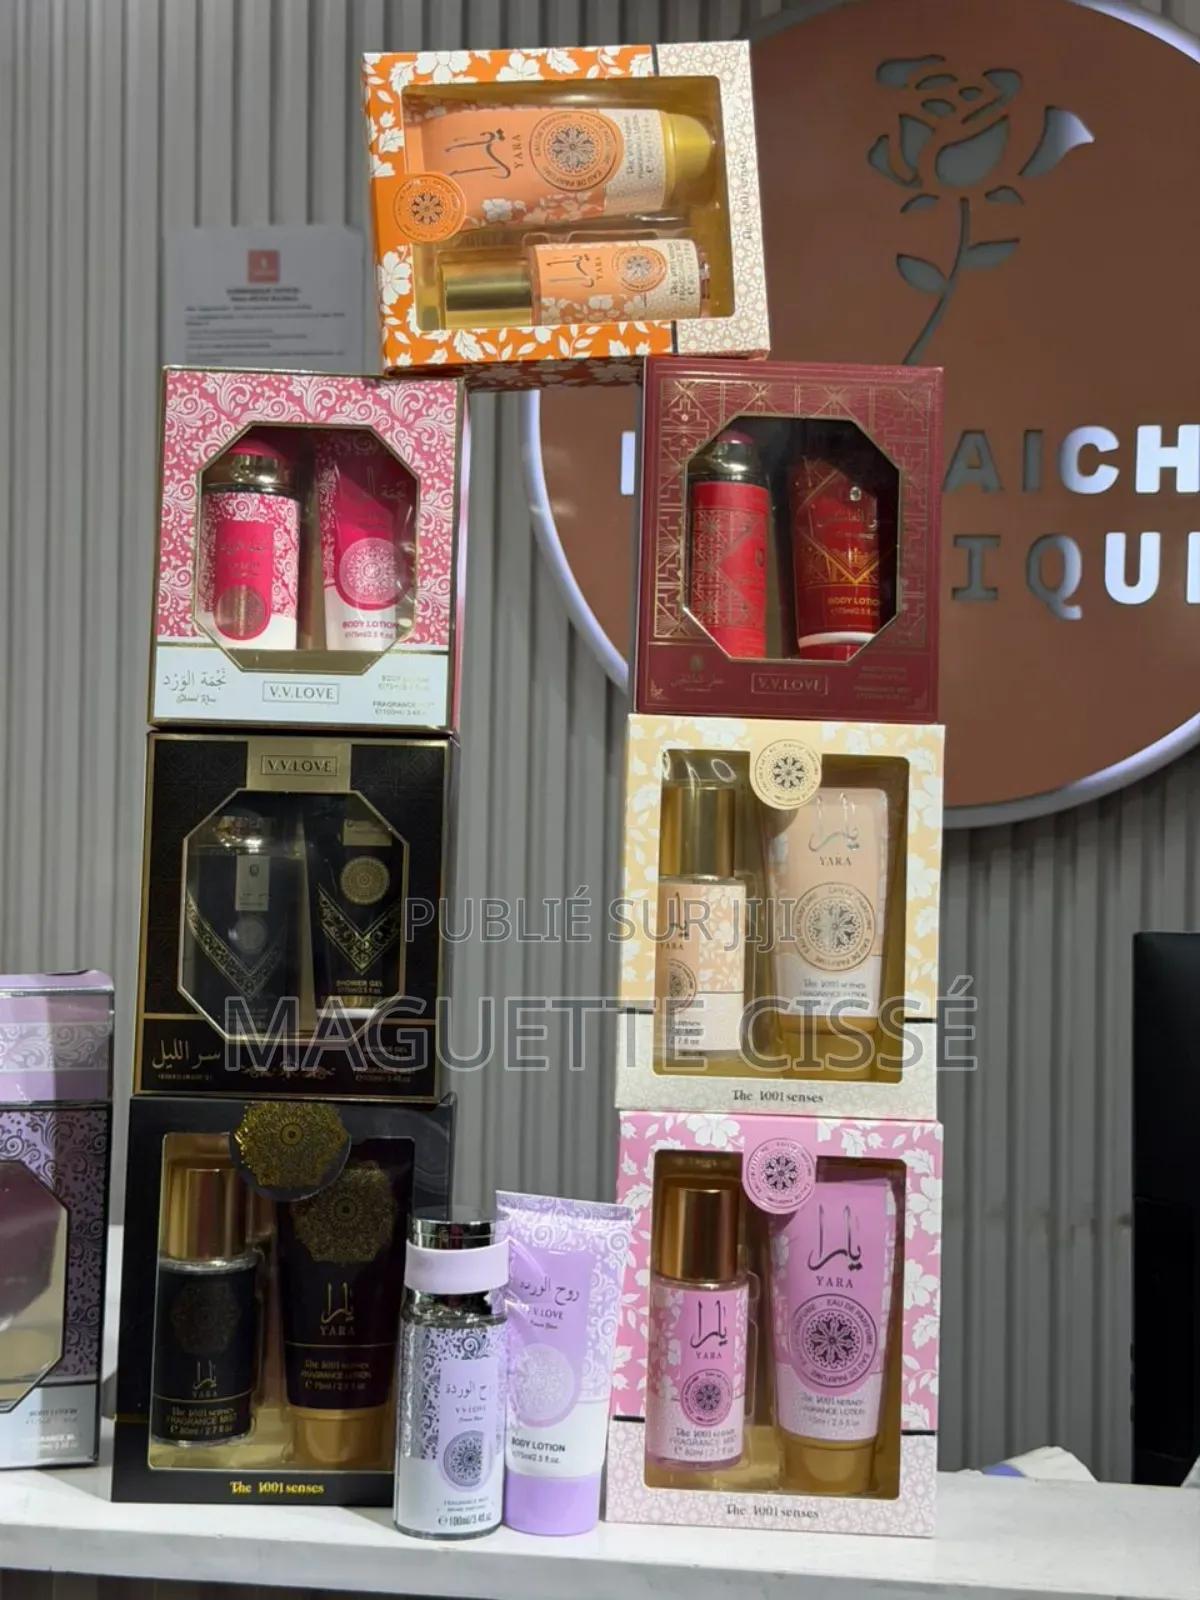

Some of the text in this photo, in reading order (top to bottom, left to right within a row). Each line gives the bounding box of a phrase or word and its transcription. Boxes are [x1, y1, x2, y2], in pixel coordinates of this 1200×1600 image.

[512, 134, 523, 169] YARA
[269, 686, 335, 700] V.V.LOVE
[267, 760, 332, 772] V.V.LOVE
[819, 856, 853, 866] YARA
[731, 1089, 753, 1100] The
[786, 1094, 824, 1103] senses
[815, 1275, 854, 1289] YARA
[320, 1326, 355, 1336] YARA
[696, 1352, 722, 1360] YARA
[532, 1441, 566, 1452] LOTION
[229, 1481, 324, 1494] The 1001 senses
[725, 1504, 746, 1515] The
[781, 1508, 819, 1518] senses
